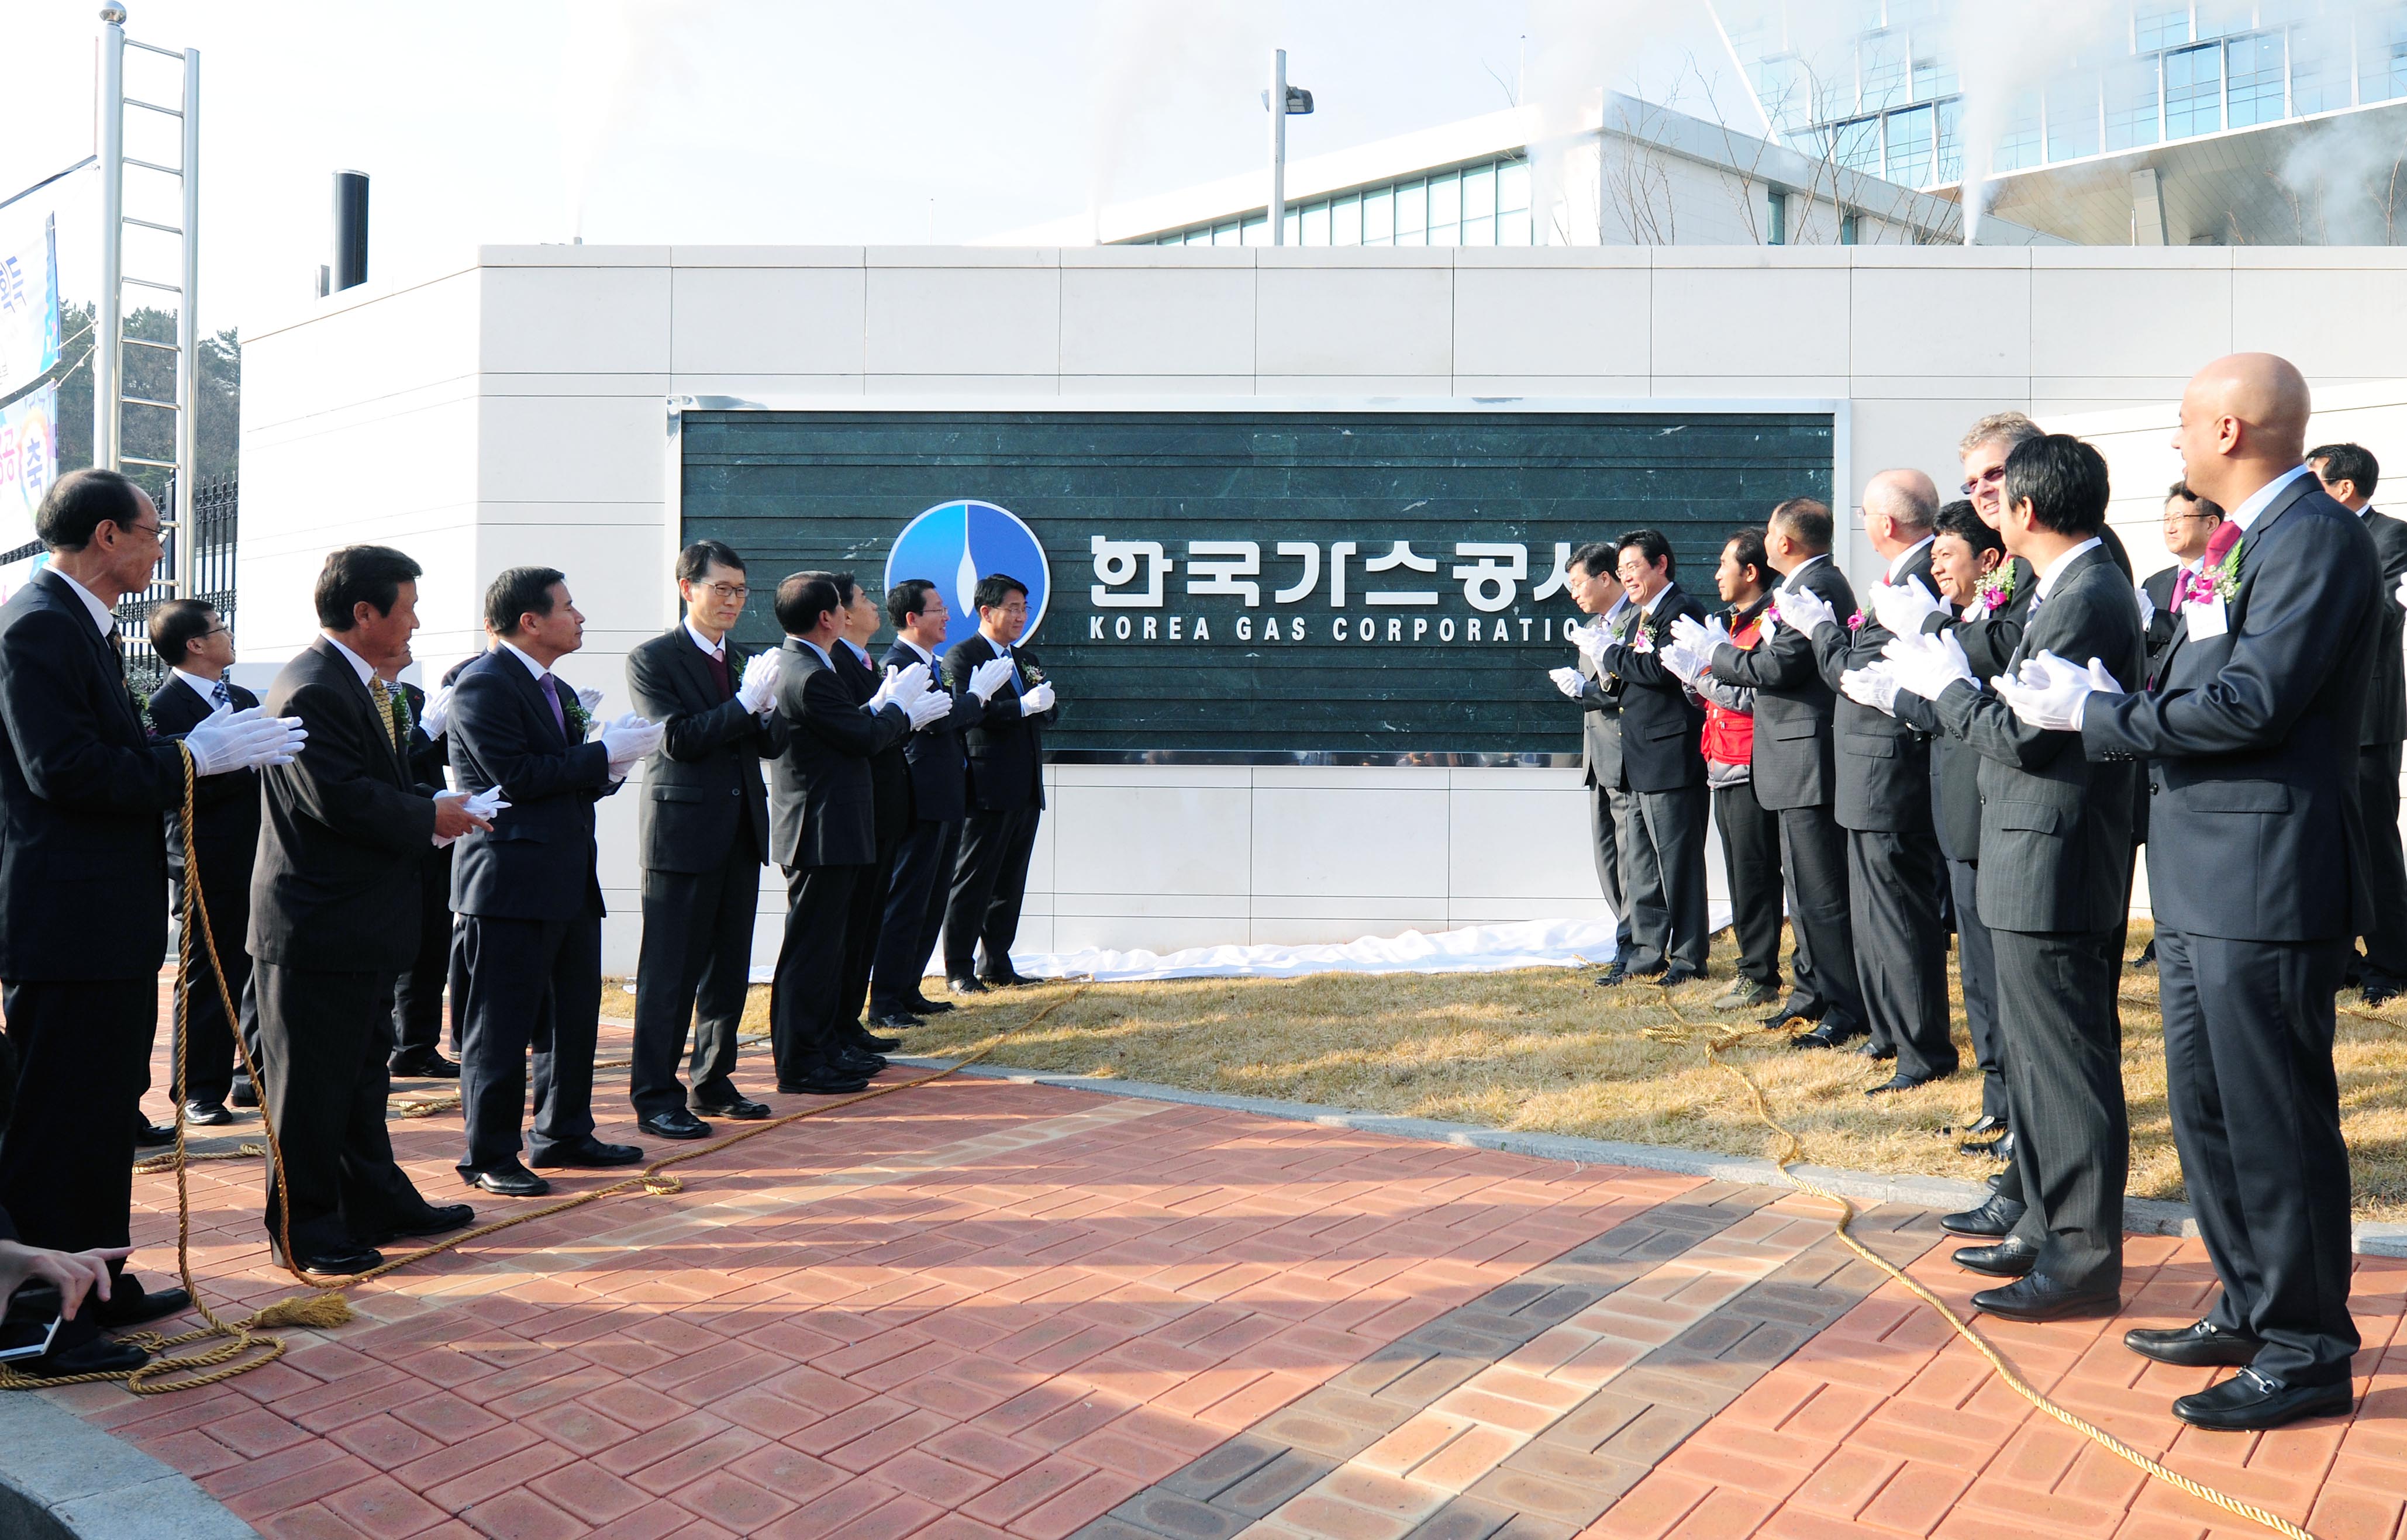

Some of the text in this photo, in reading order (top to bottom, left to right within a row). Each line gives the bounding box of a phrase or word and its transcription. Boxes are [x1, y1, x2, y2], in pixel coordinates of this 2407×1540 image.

[0, 428, 15, 485] 공
[26, 437, 43, 498] 축
[1089, 616, 1578, 642] KOREA GAS CORPORATIO
